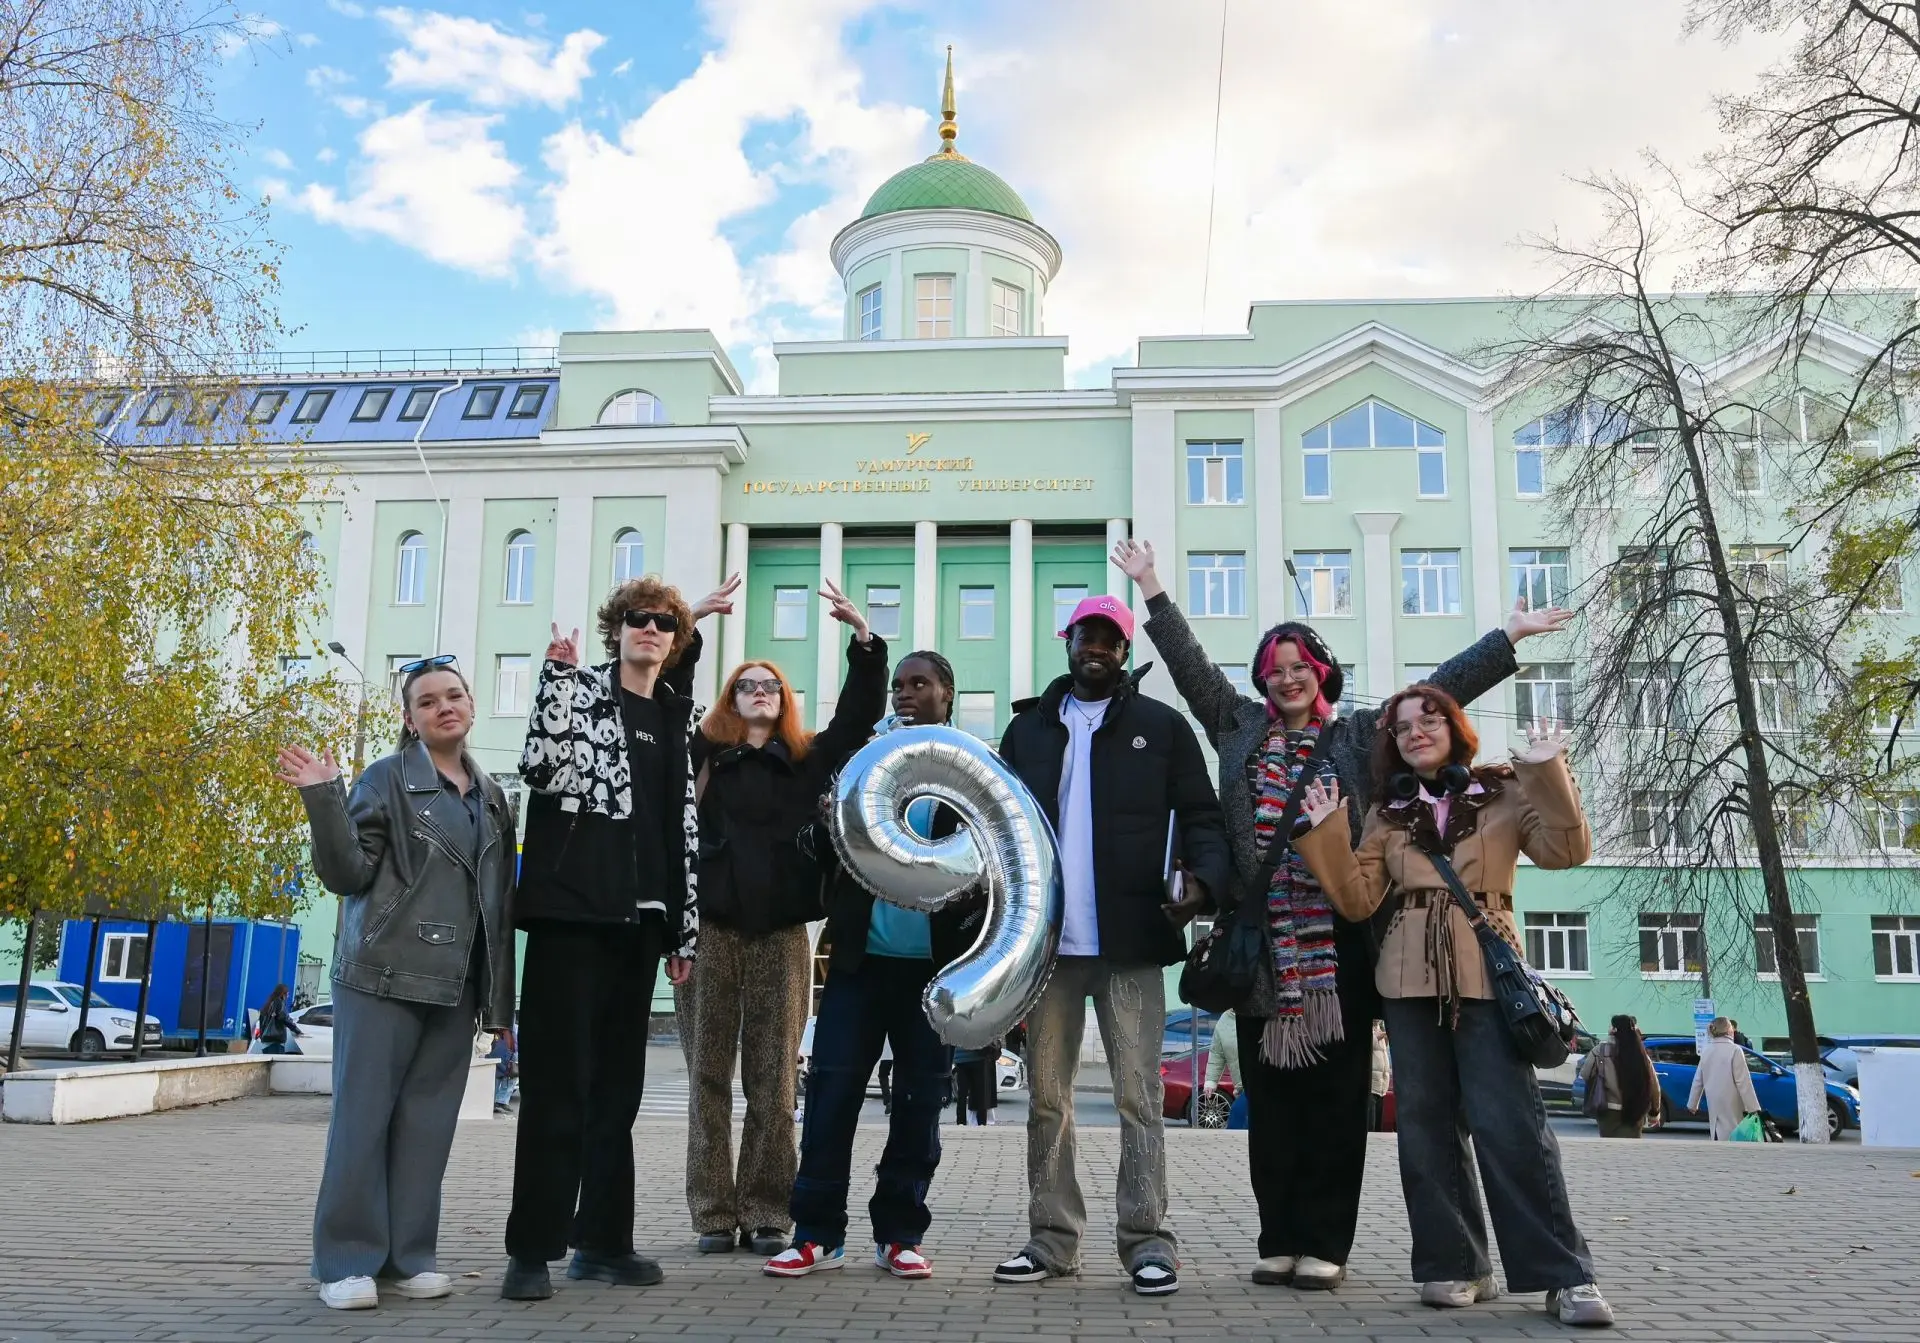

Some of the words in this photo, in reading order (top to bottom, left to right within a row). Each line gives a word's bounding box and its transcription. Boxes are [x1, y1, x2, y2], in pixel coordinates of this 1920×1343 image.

[857, 456, 975, 475] УДМУРТСКИЙ
[743, 478, 931, 495] ГОСУДАРСТВЕННЫЙ
[958, 479, 1095, 492] УНИВЕРСИТЕТ
[1099, 601, 1117, 612] alo
